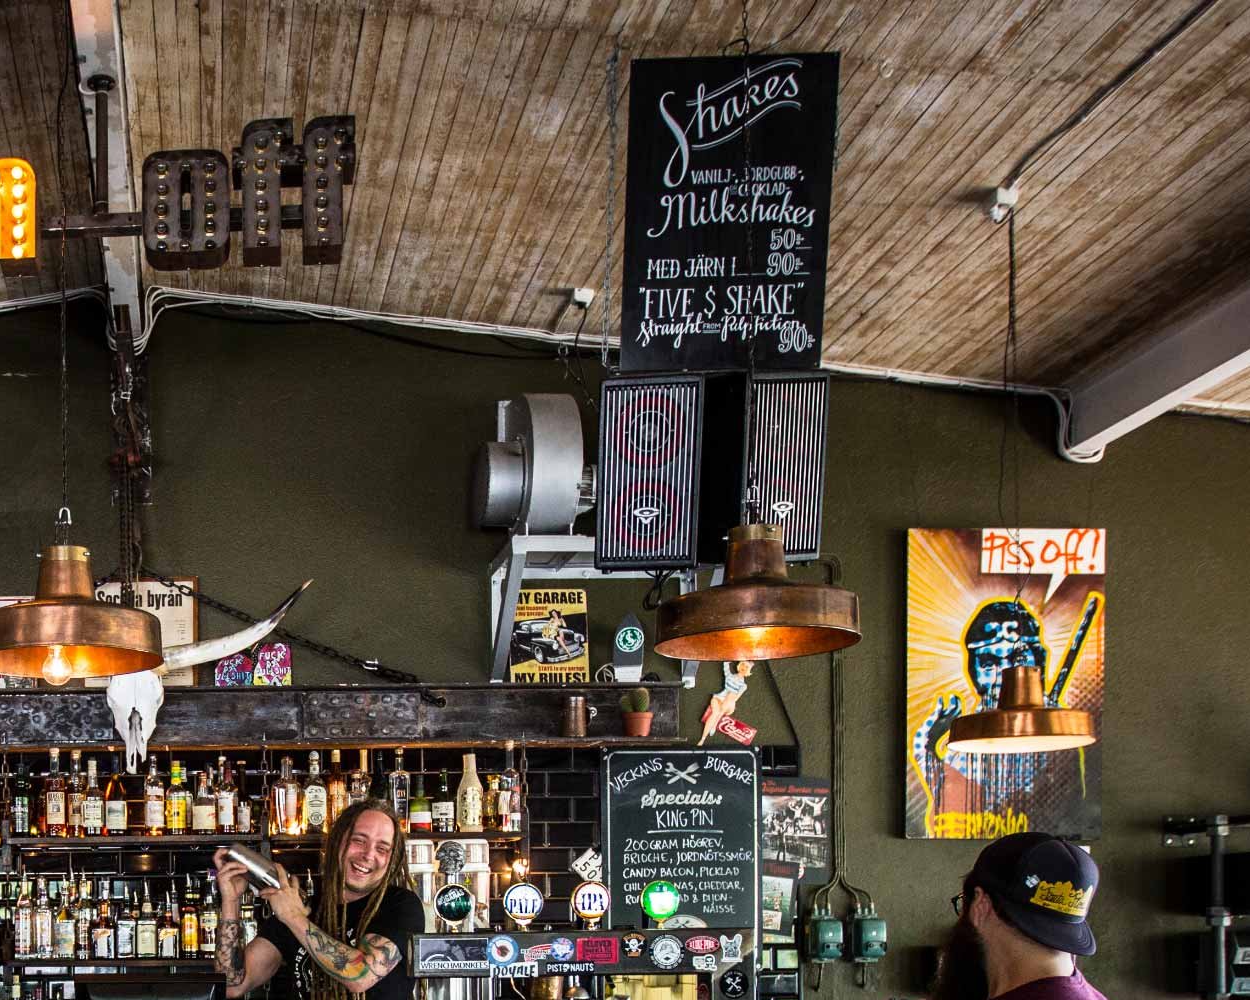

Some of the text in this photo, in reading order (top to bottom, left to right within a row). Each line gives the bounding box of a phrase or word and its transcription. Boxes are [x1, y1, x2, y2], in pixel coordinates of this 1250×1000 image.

[659, 72, 799, 188] Shakes
[646, 185, 816, 238] Milkshakes
[647, 258, 680, 280] MED
[685, 254, 725, 278] JÄRN
[703, 286, 717, 317] $
[636, 313, 703, 348] Straight
[147, 589, 183, 610] byrån
[534, 592, 583, 604] GARAGE
[259, 651, 286, 661] FUCK
[514, 672, 586, 683] MY RULES!
[611, 756, 754, 792] VECKANS BURGARE
[624, 838, 649, 851] 200
[650, 838, 678, 850] GRAM
[623, 867, 657, 879] CANDY
[700, 866, 740, 877] PICKLAD
